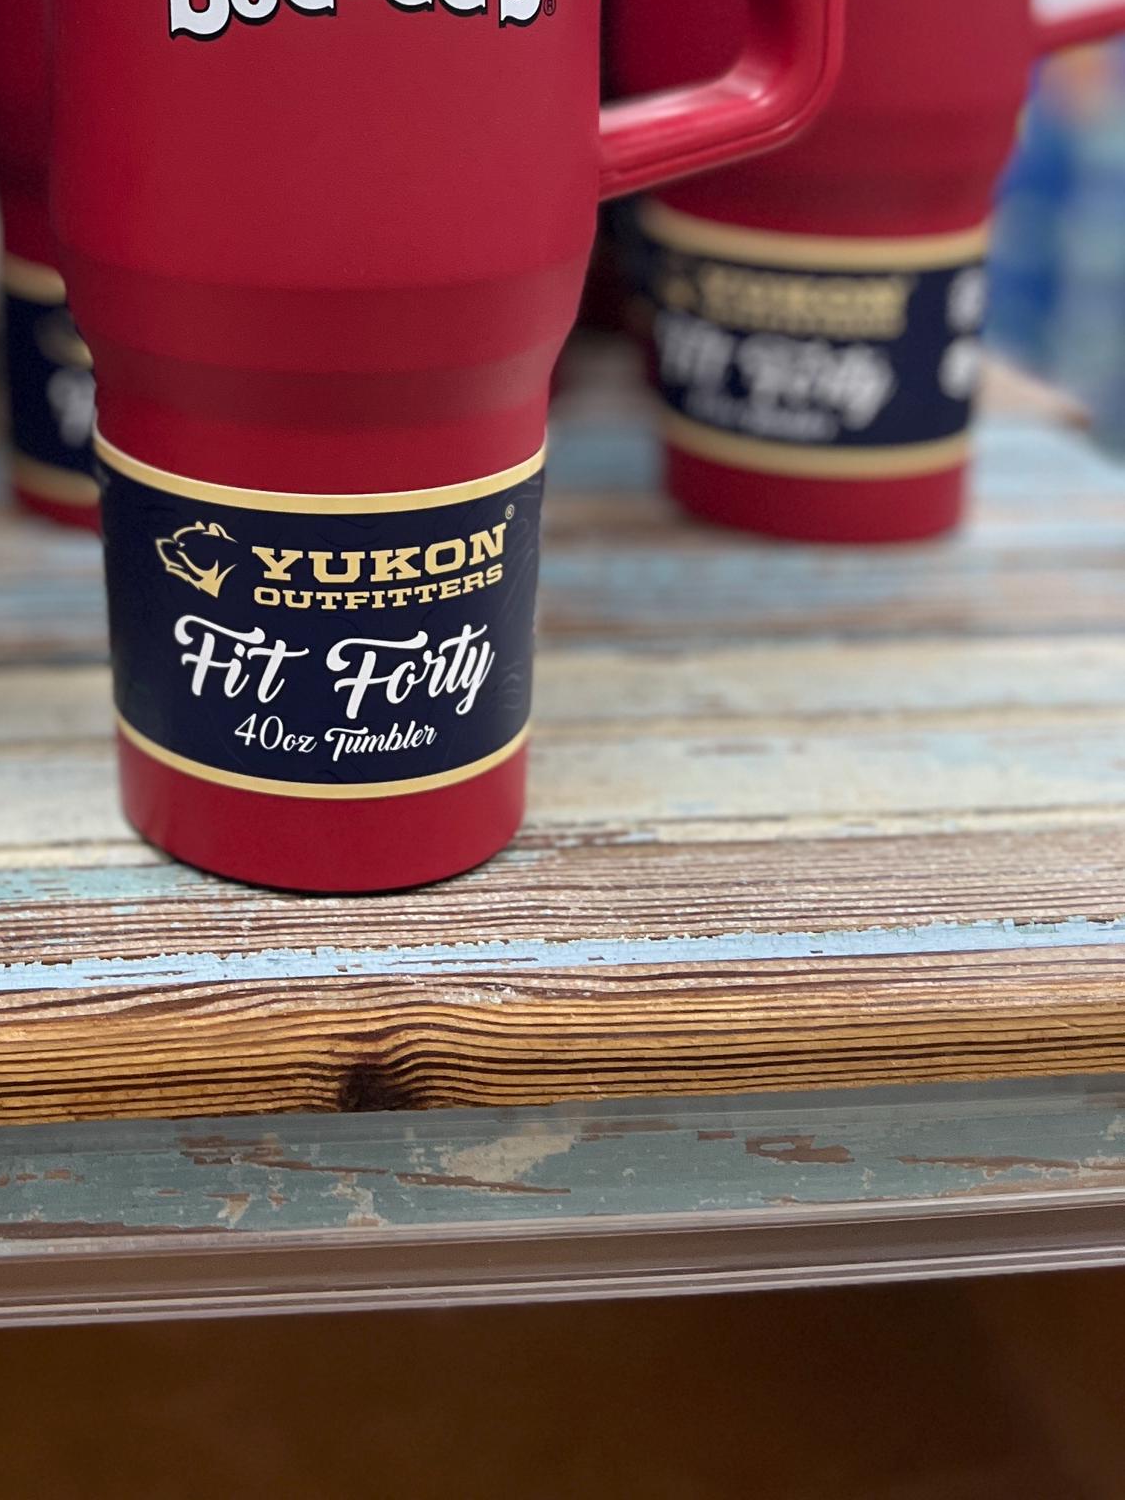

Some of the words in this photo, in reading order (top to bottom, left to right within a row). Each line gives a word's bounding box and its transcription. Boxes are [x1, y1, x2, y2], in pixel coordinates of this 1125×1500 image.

[251, 522, 507, 584] YUKON
[253, 563, 503, 609] OUTFITTERS
[174, 614, 310, 703] Fit
[326, 623, 495, 719] Forty
[234, 712, 318, 753] 40oz
[324, 720, 437, 762] Tumbler
